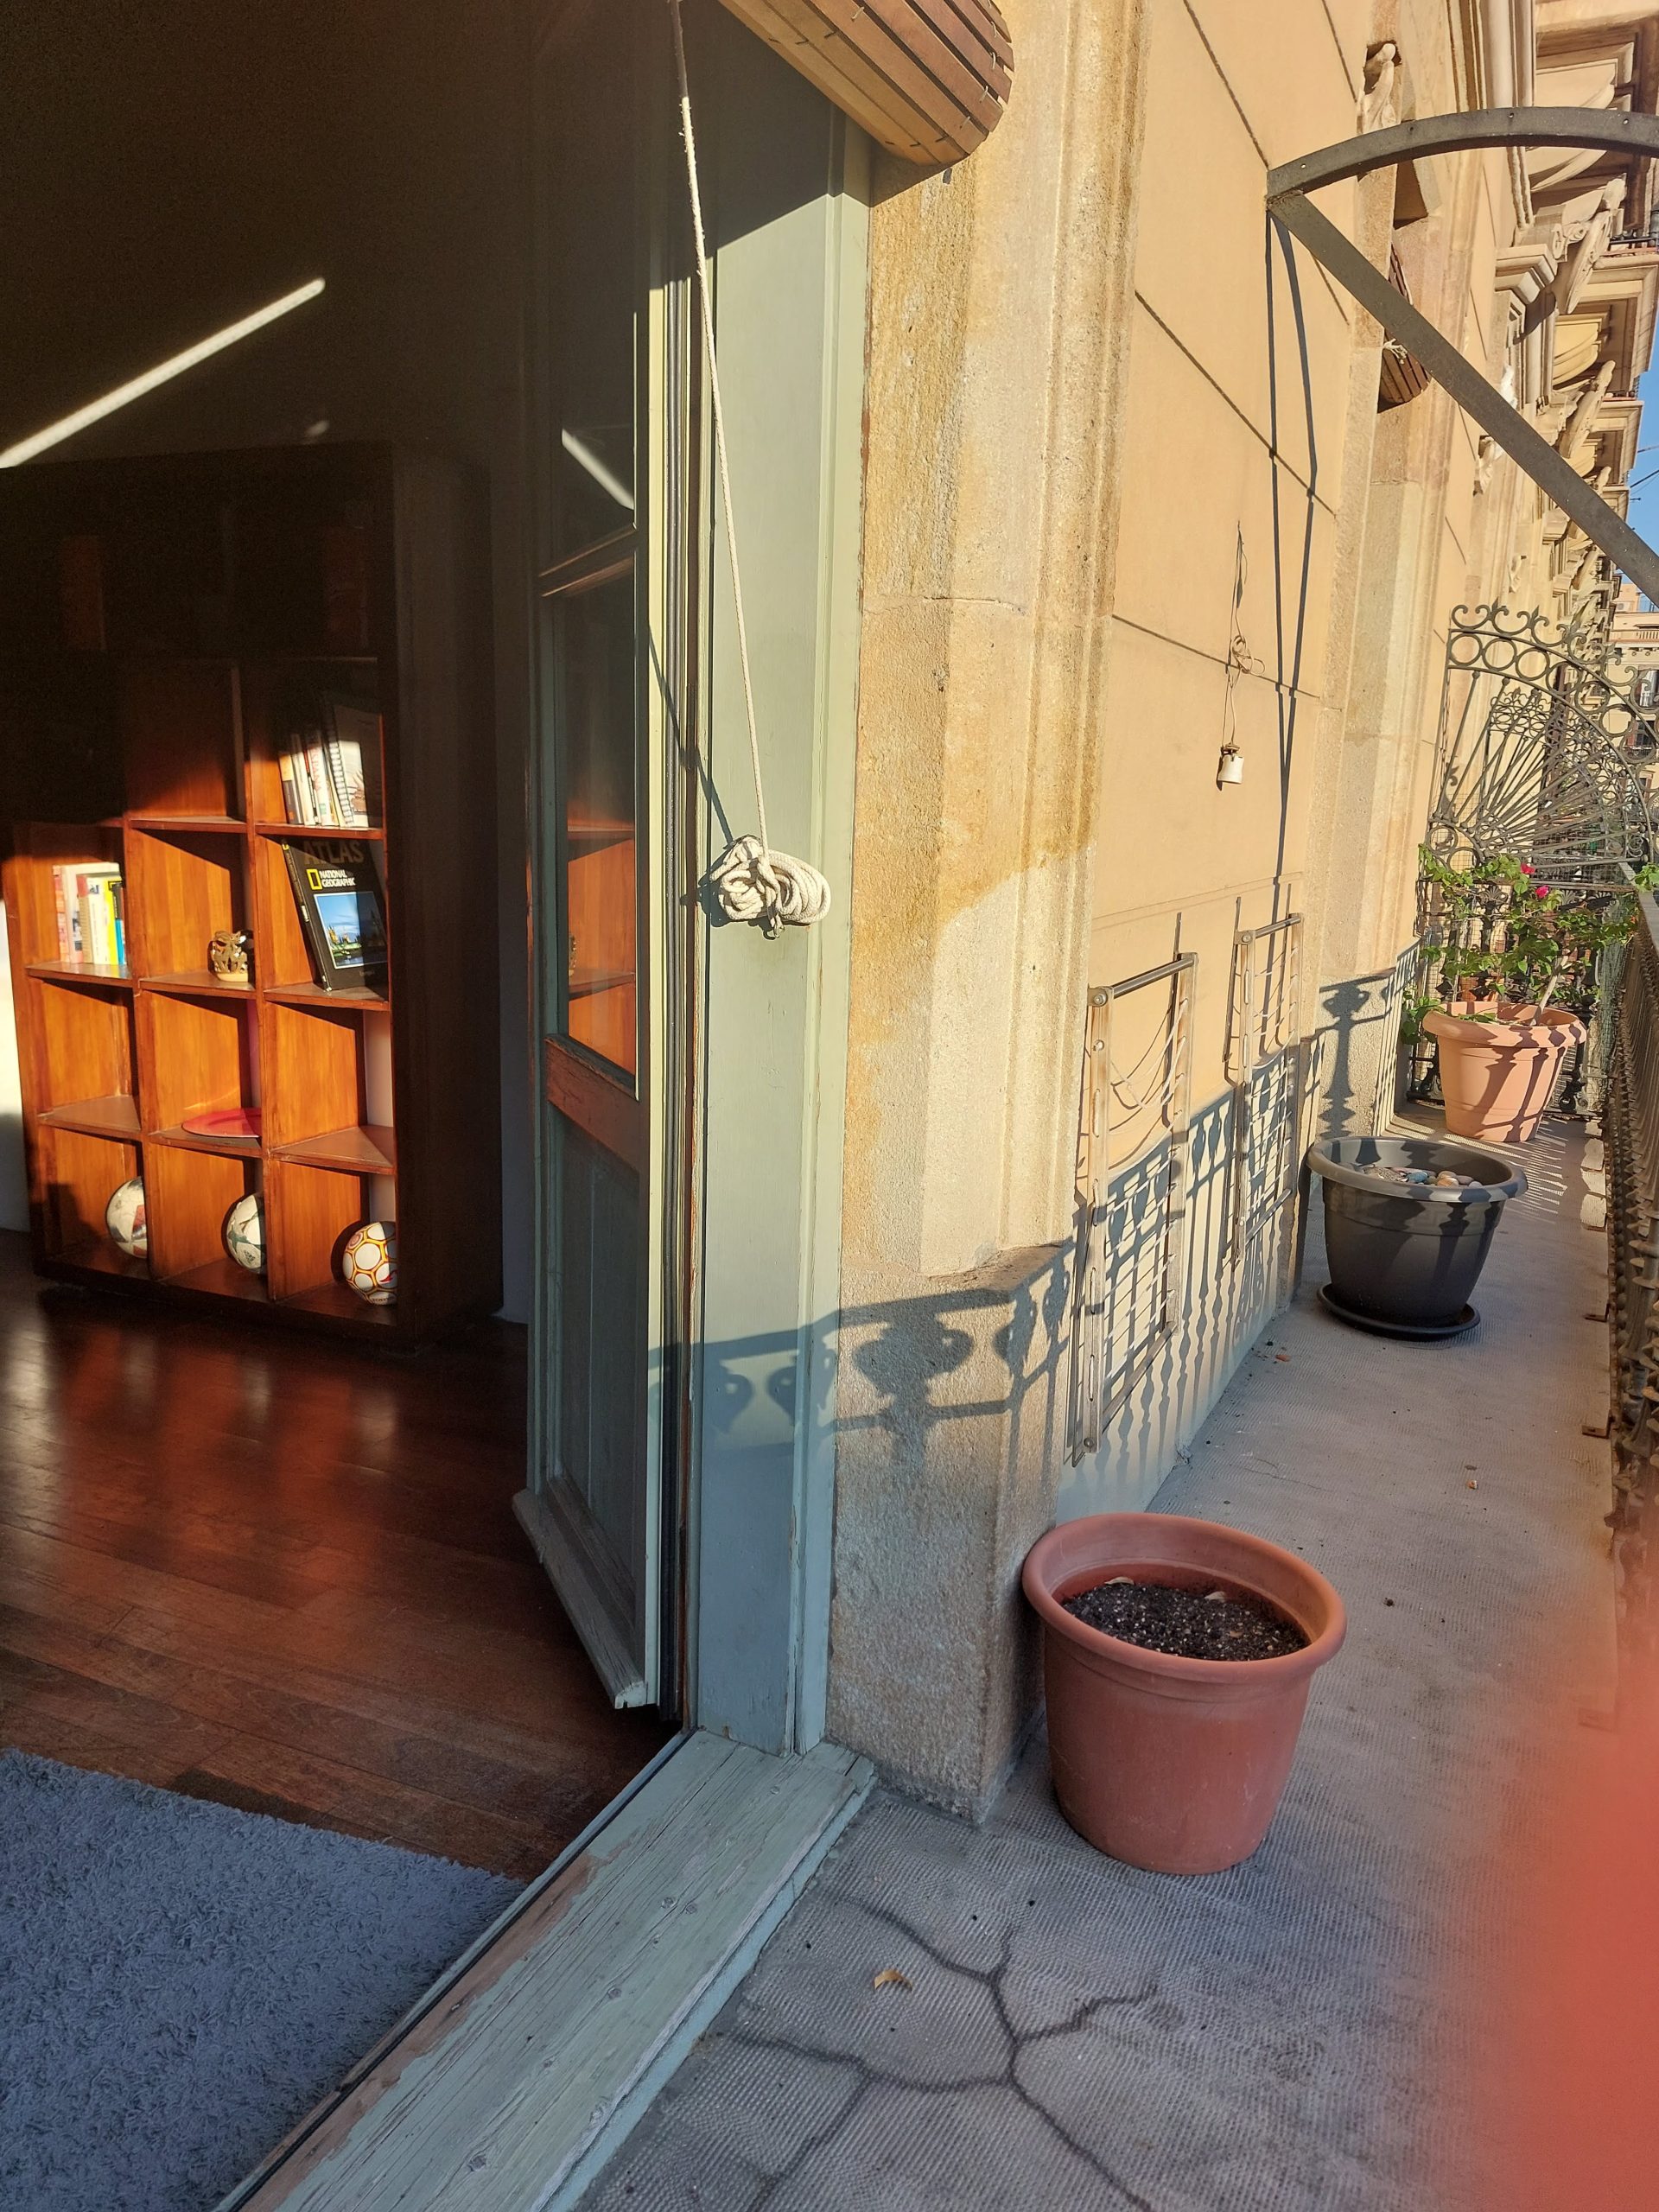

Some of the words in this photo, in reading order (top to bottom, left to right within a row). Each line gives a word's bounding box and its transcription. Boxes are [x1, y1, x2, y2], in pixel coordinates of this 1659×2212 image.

[303, 840, 365, 865] ATLAS
[319, 869, 347, 879] NATIONAL
[321, 877, 356, 888] GEOGRAPHIC
